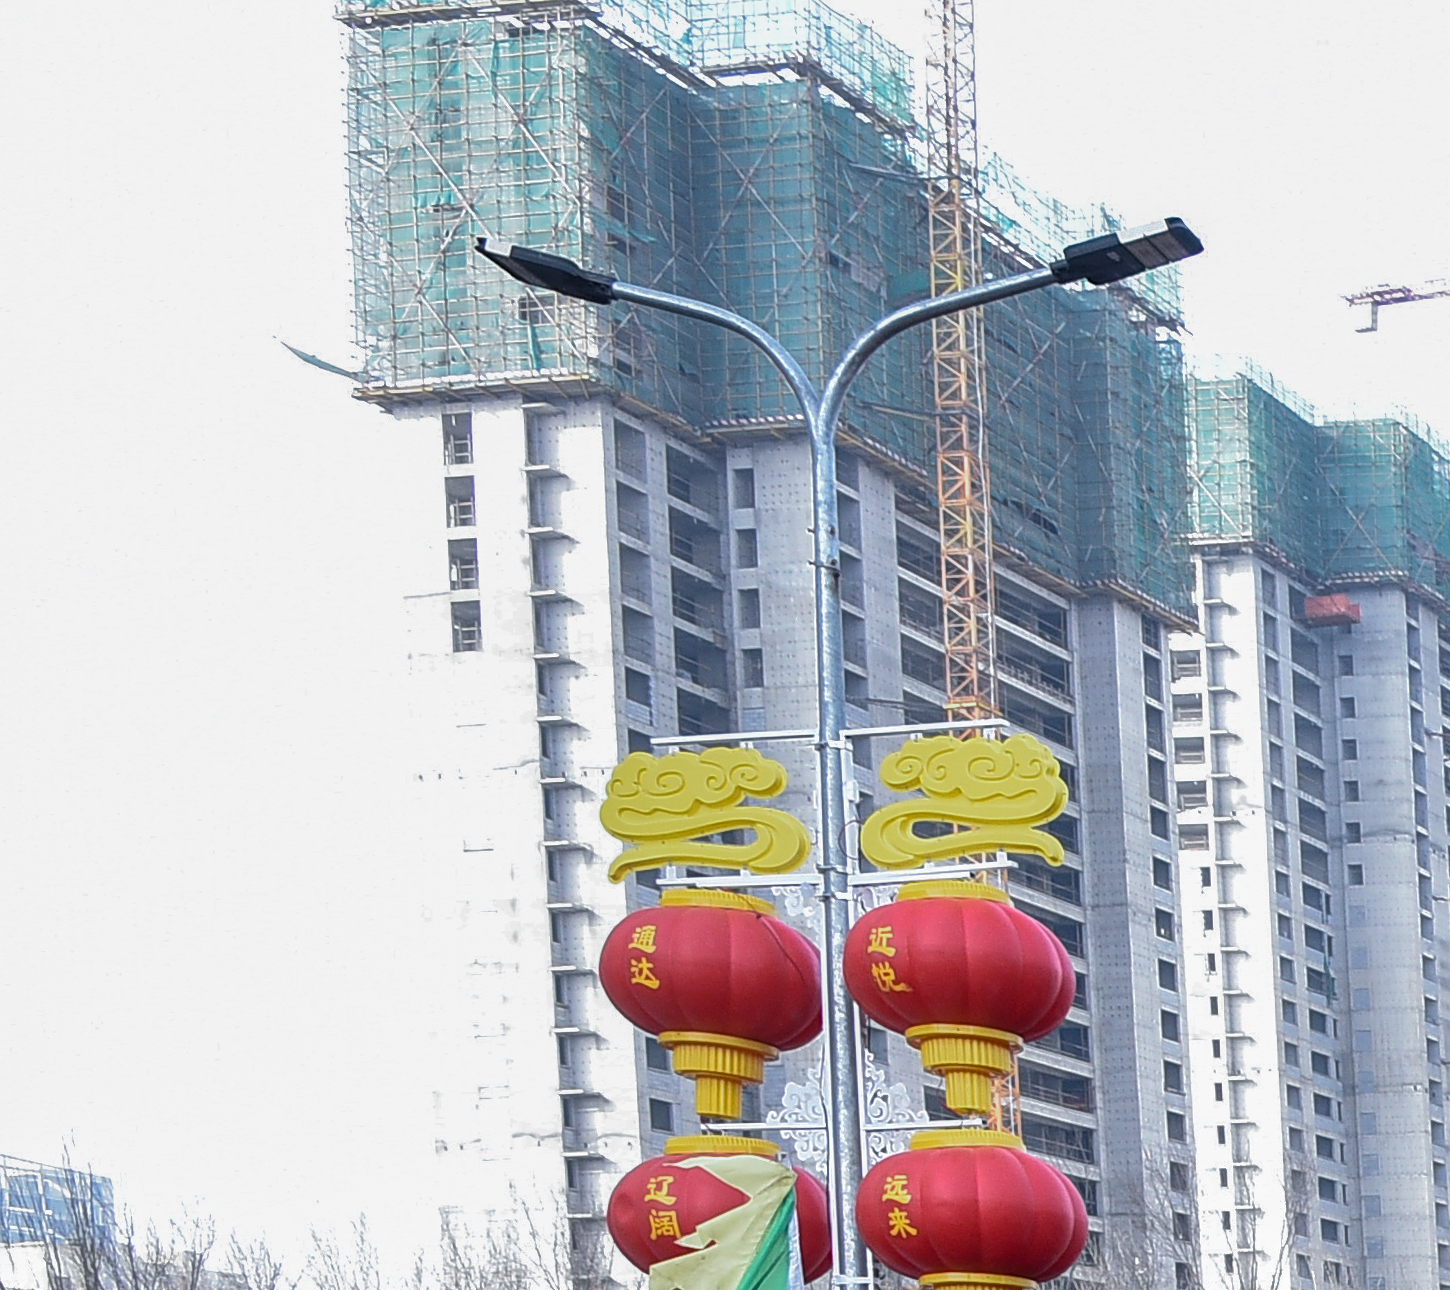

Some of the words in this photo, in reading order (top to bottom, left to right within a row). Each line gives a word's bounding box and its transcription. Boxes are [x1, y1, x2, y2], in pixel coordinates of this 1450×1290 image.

[629, 924, 661, 990] 通达
[867, 926, 912, 994] 近悦
[644, 1175, 684, 1240] 辽阔
[882, 1175, 918, 1239] 远来
